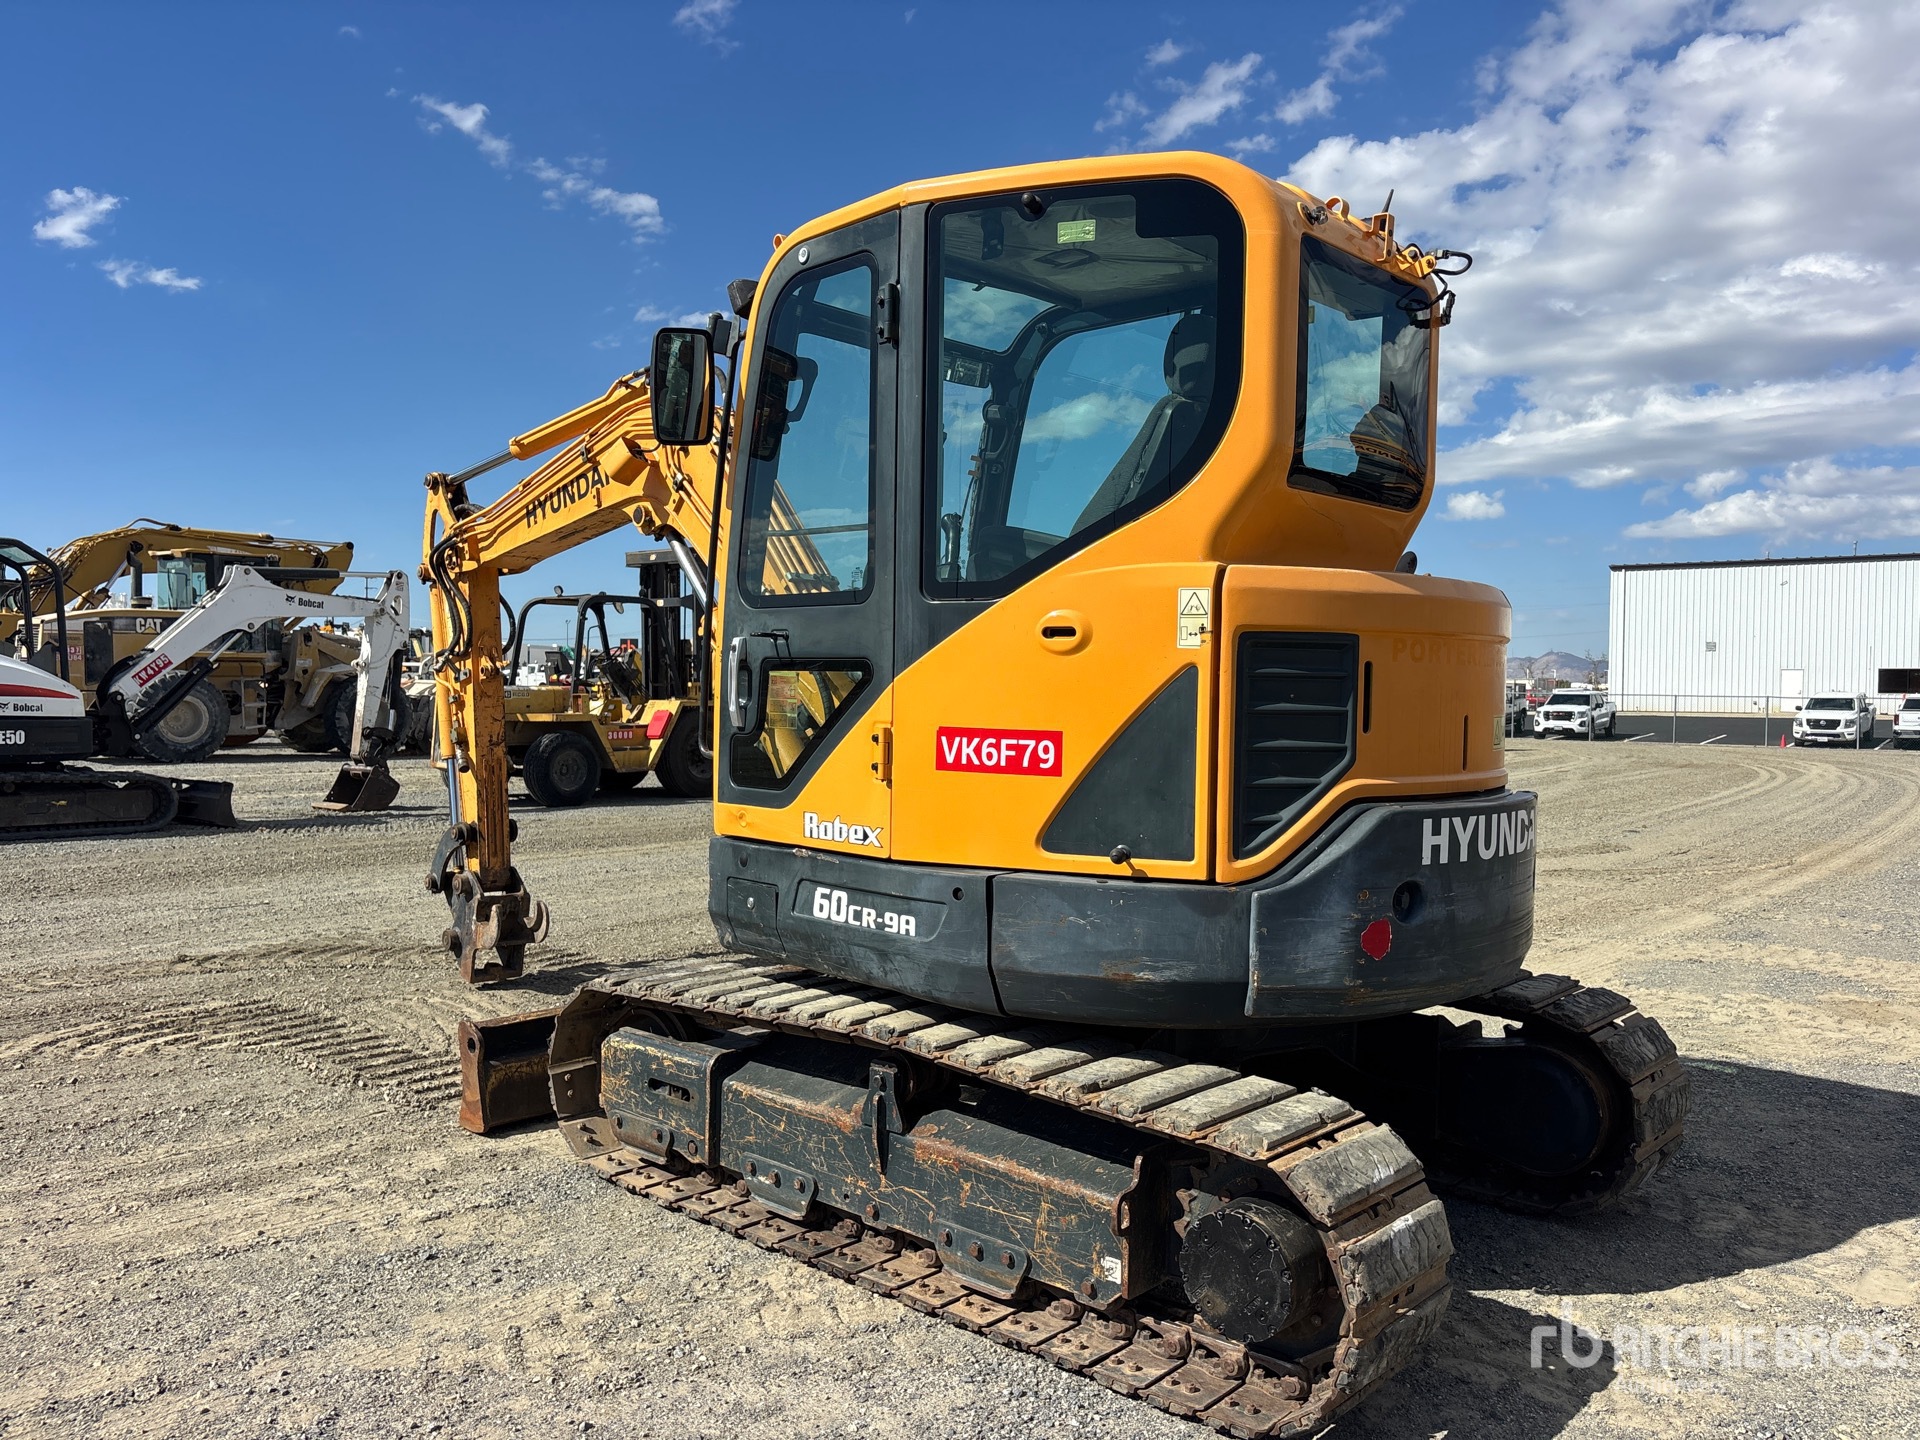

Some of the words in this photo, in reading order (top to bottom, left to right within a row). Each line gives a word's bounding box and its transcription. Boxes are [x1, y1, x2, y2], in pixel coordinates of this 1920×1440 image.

[298, 598, 324, 609] Bobcat
[136, 618, 163, 634] CAT
[133, 654, 169, 685] KW4Y95
[13, 702, 43, 712] Bobcat
[0, 729, 26, 745] E50
[940, 735, 1056, 769] VK6F79
[803, 811, 884, 848] Robex
[812, 886, 916, 937] 60CR-9A
